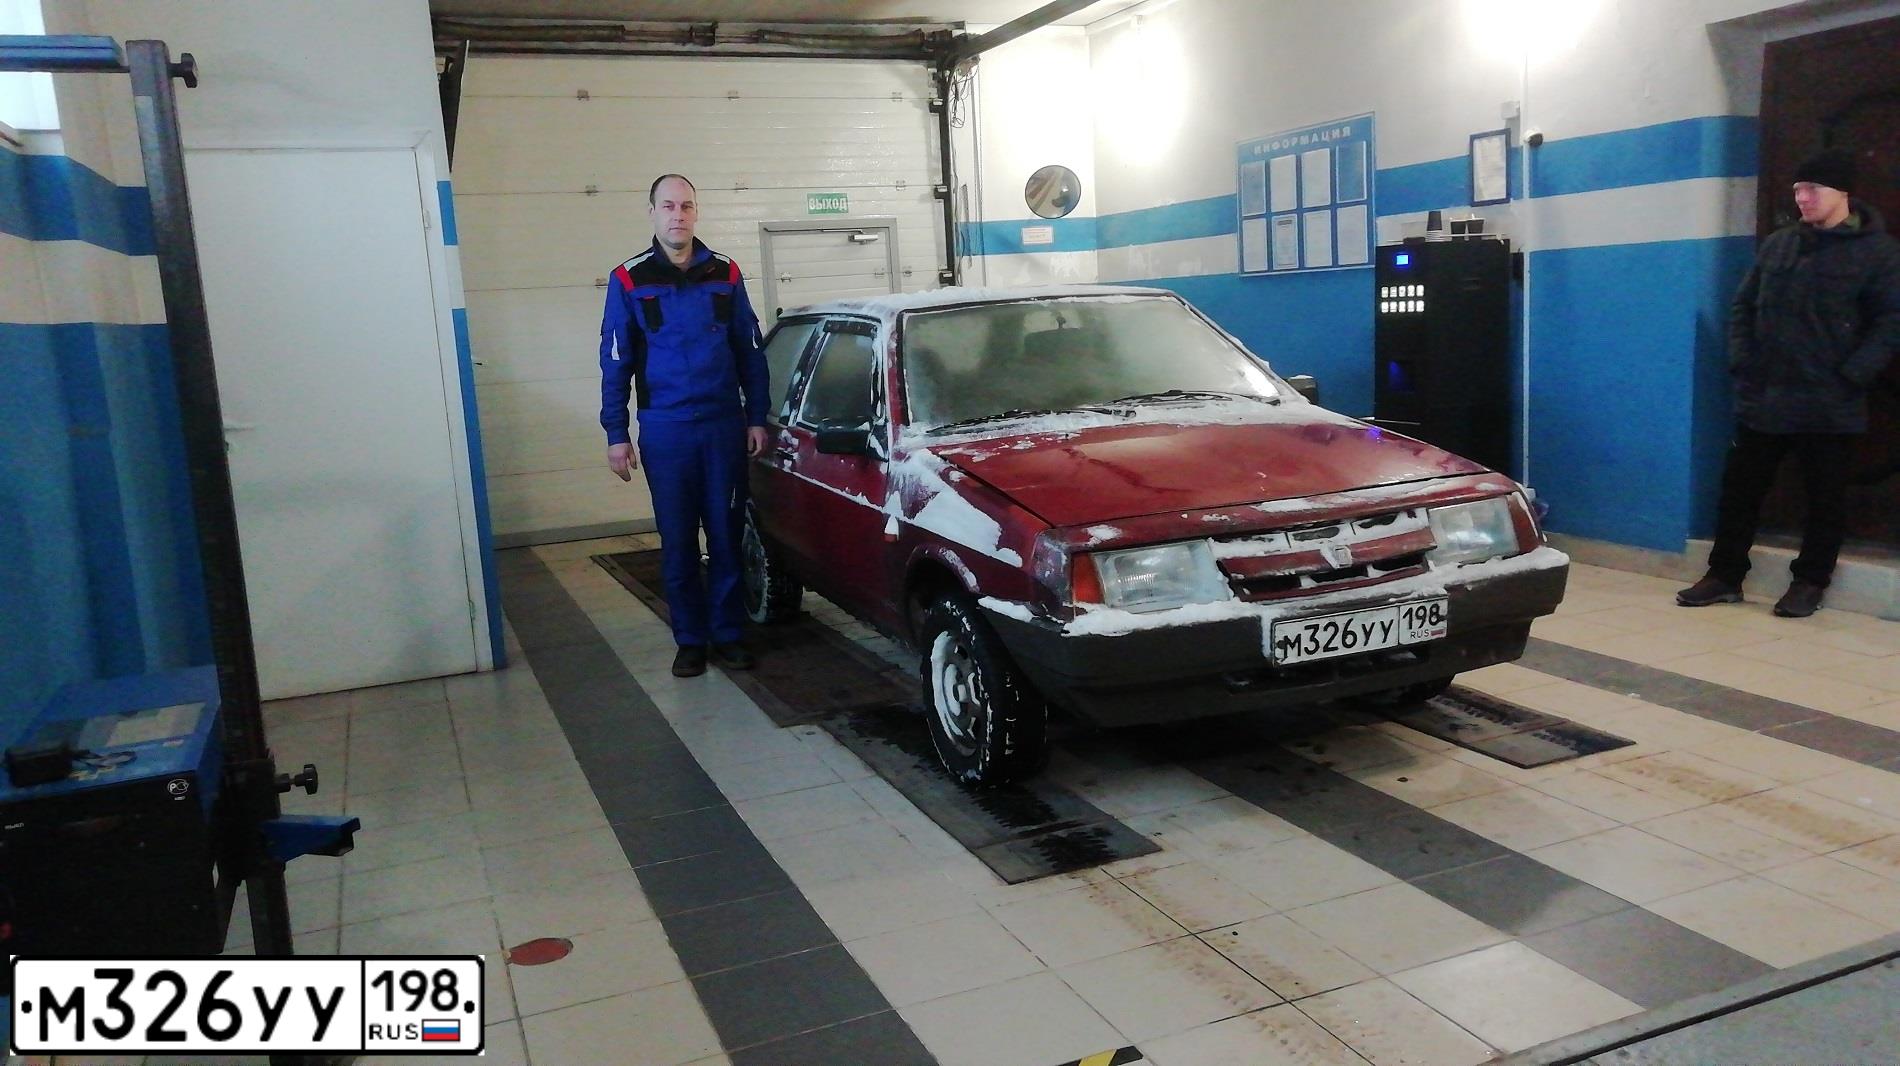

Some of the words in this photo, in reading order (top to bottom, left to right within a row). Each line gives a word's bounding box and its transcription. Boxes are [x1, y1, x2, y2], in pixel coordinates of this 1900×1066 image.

[1254, 126, 1351, 155] ИНФОРМАЦИЯ
[808, 198, 847, 211] ВЫХОД
[1283, 618, 1394, 657] М326УУ
[1402, 603, 1440, 630] 198
[1410, 629, 1430, 639] RUS
